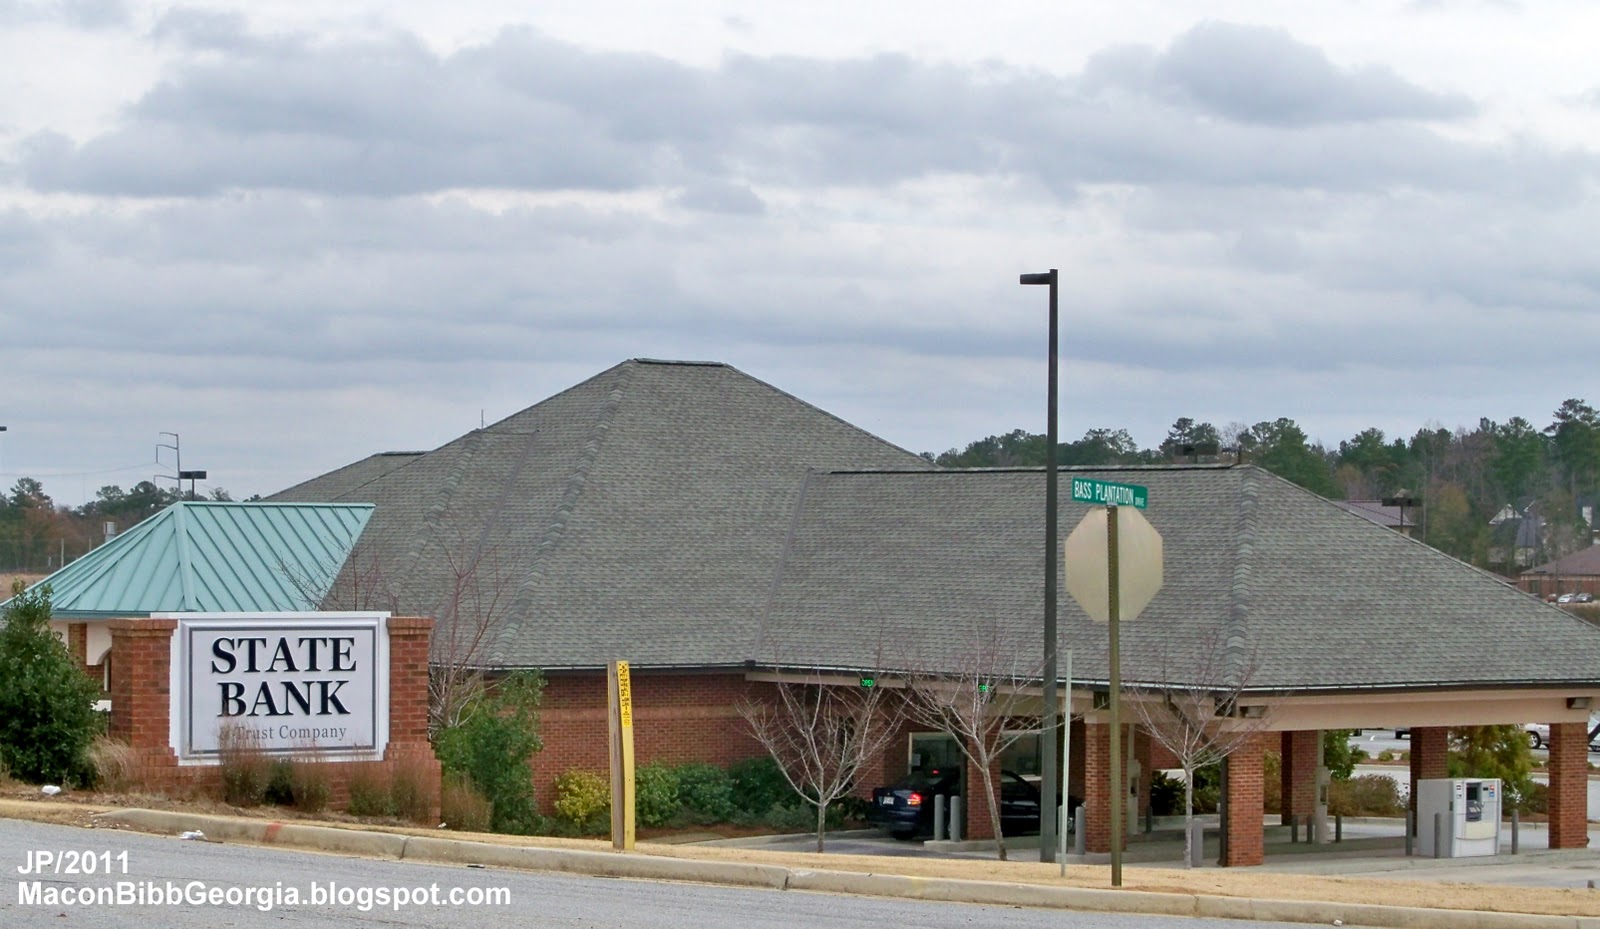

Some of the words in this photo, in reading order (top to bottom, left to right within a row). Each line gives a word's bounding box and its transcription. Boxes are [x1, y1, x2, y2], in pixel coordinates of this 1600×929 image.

[1074, 480, 1092, 499] BASS
[1095, 483, 1134, 505] PLANTATION
[211, 637, 357, 674] STATE
[217, 681, 351, 717] BANK
[235, 724, 274, 740] Trust
[279, 724, 347, 741] Company
